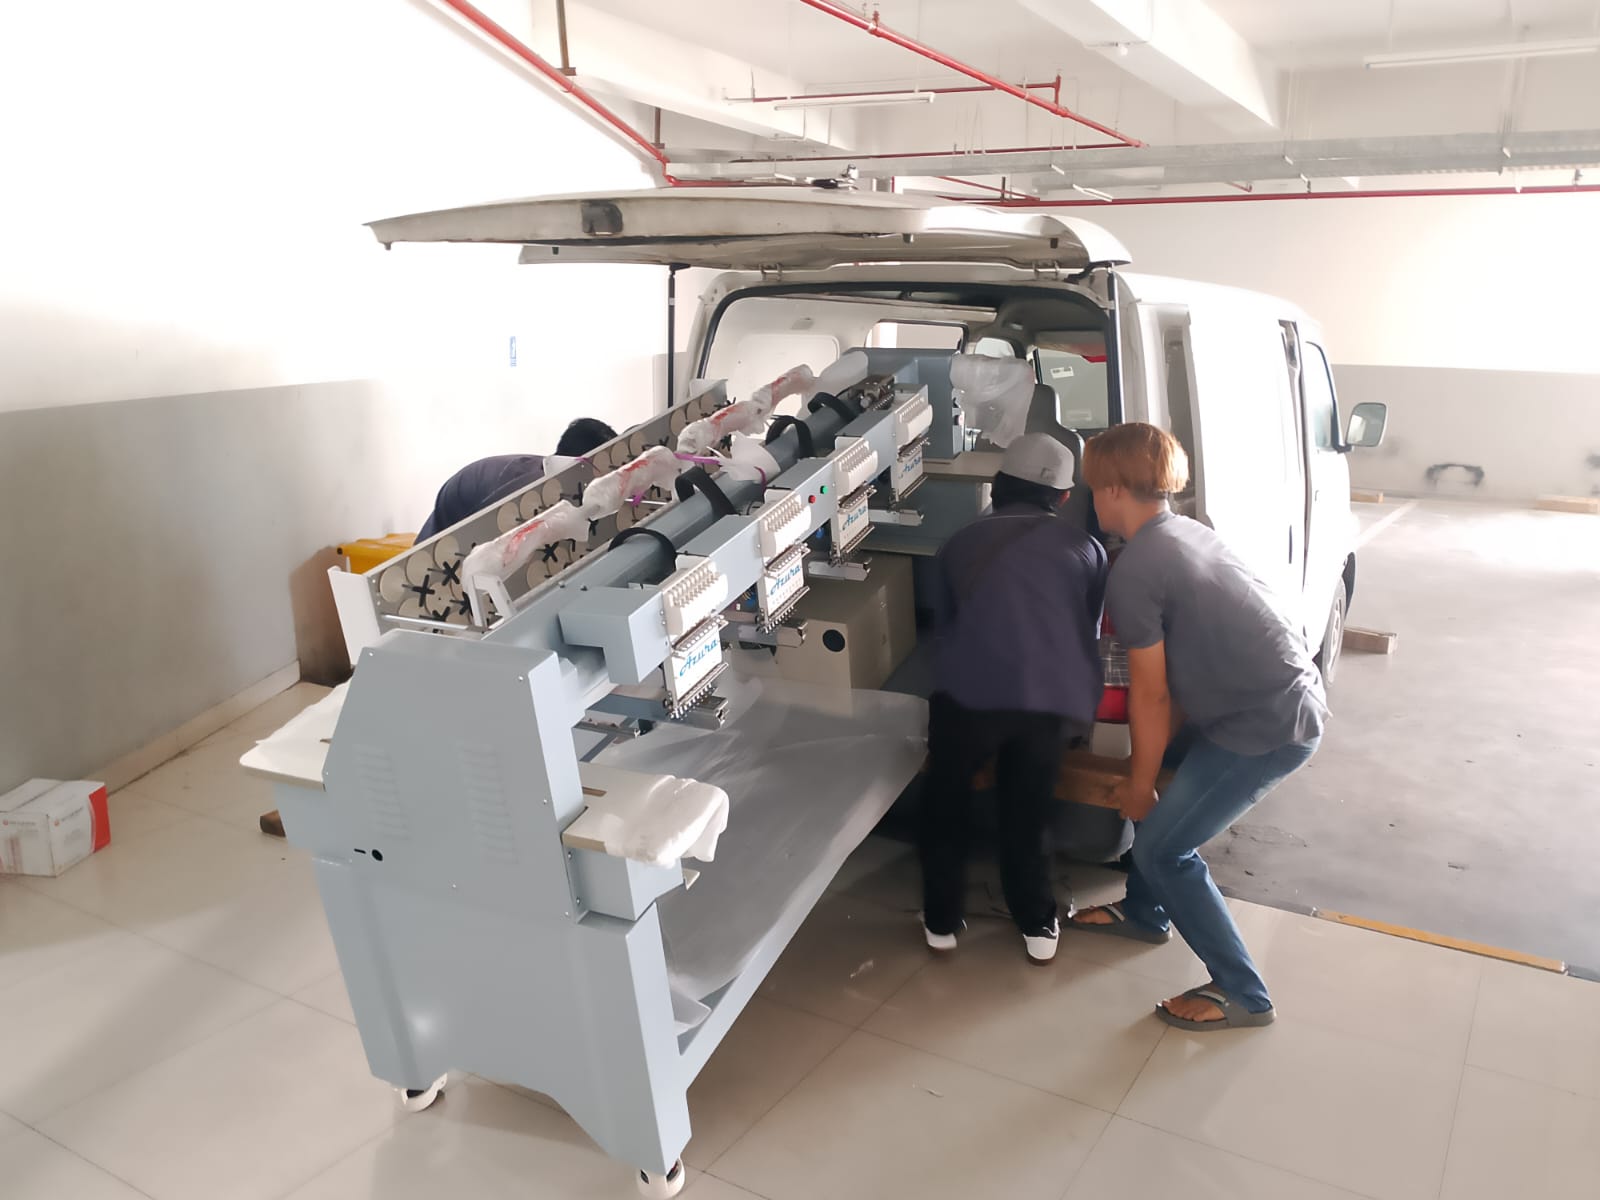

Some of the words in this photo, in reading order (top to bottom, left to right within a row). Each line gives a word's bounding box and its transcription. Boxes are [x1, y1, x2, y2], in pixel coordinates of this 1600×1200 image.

[842, 505, 867, 531] Azura
[770, 564, 801, 596] Azura
[679, 639, 718, 677] Azura
